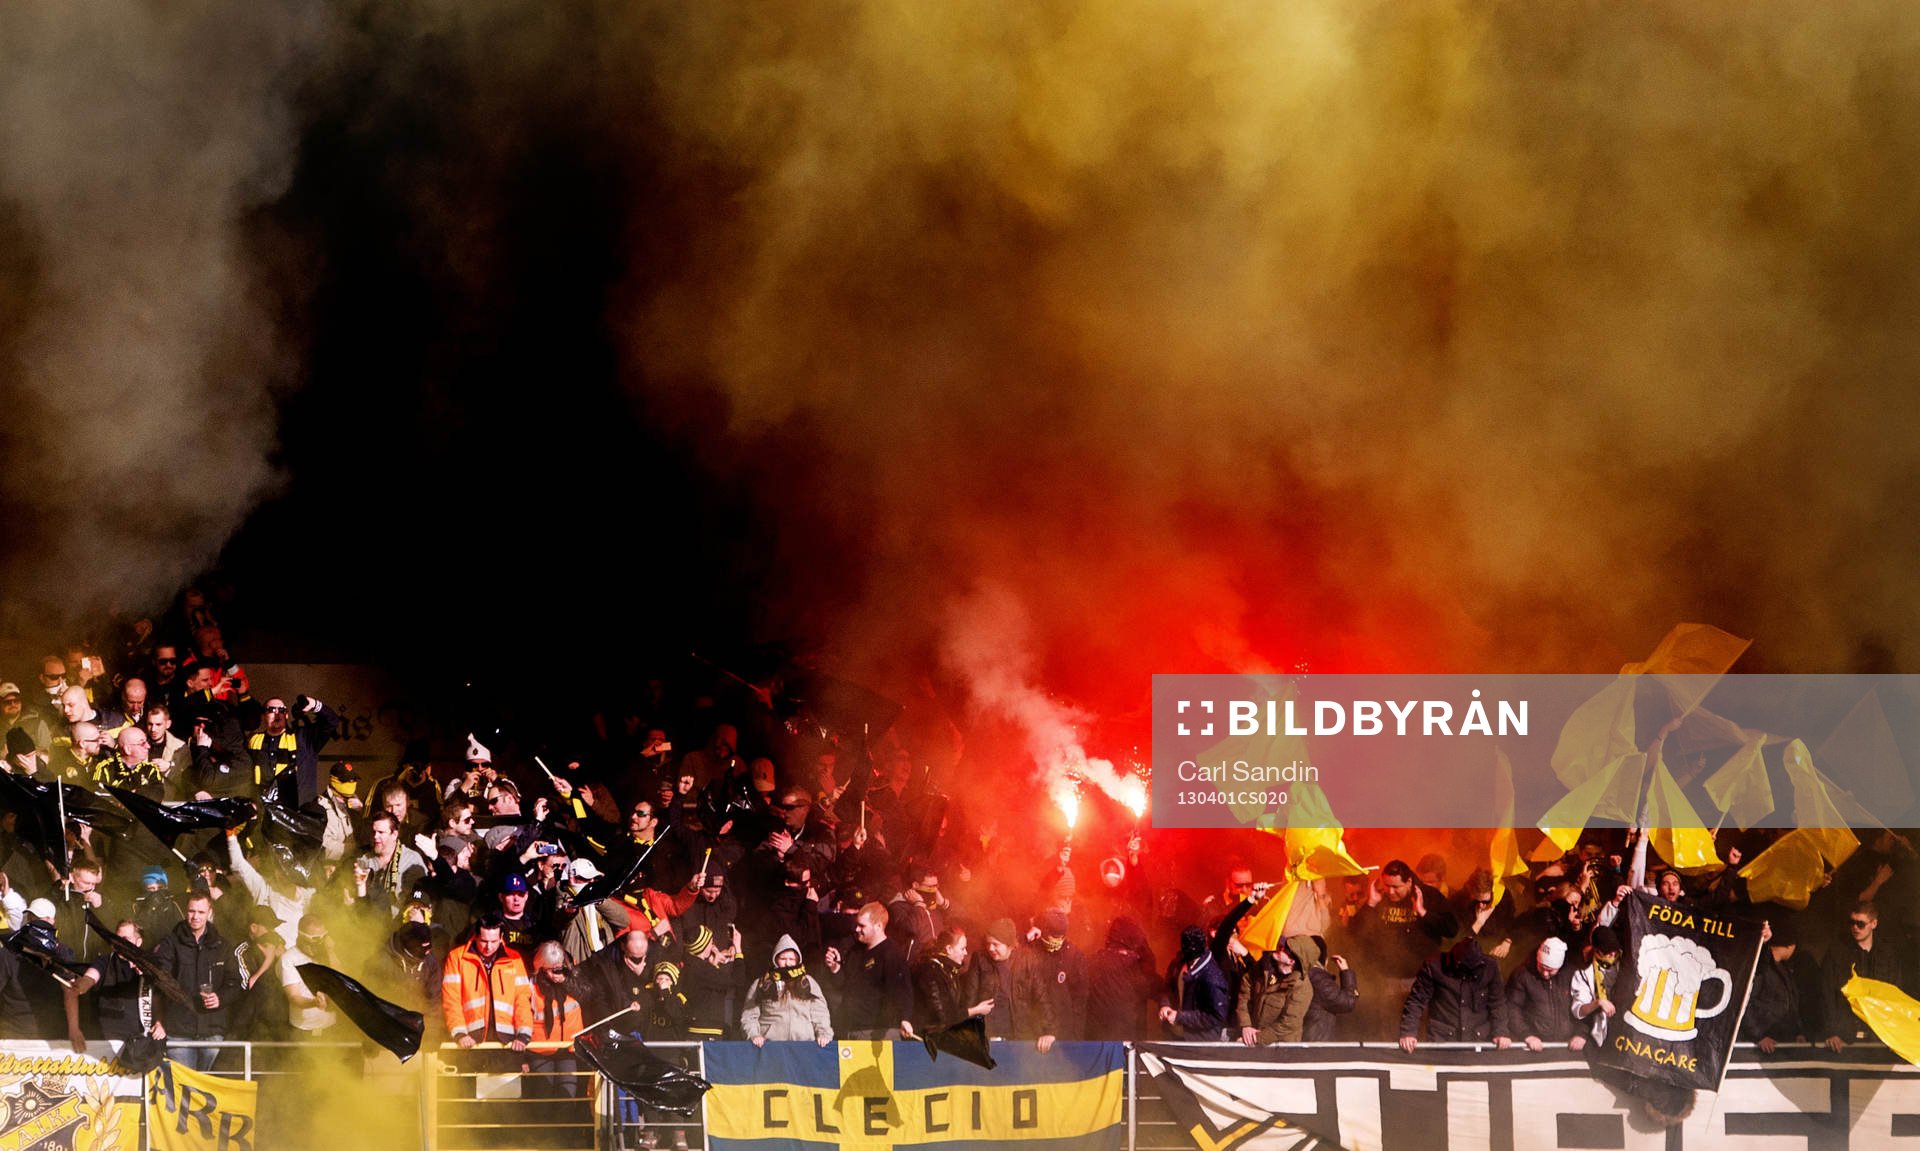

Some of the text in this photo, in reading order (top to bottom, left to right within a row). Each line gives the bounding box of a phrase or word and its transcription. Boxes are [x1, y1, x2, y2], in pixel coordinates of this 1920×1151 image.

[1648, 905, 1735, 938] FÖDA TILL
[1615, 1036, 1698, 1073] GNAGARE
[763, 1089, 1038, 1136] CLECIO
